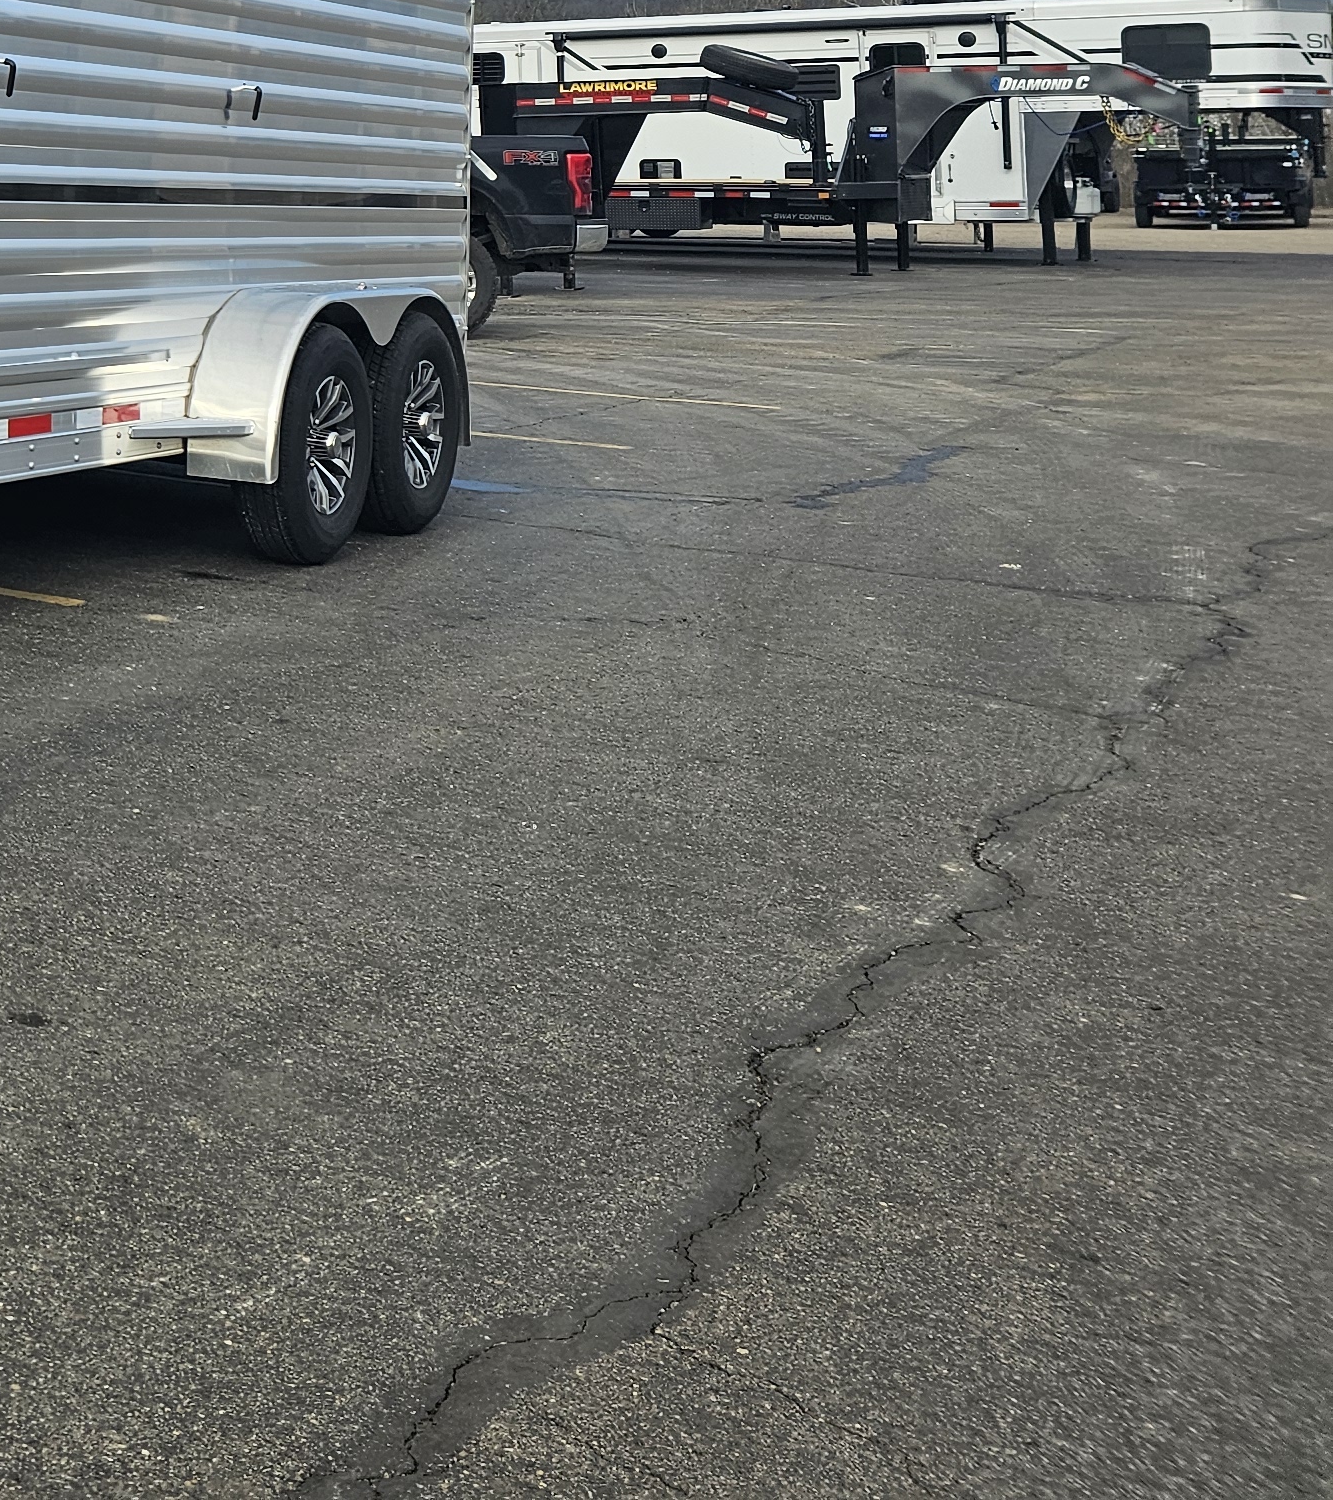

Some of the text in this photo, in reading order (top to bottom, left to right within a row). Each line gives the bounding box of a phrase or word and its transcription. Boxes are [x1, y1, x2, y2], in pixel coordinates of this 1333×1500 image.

[559, 80, 658, 93] LAWRIMORE
[1075, 76, 1091, 90] C
[503, 150, 559, 165] FX4
[773, 212, 798, 220] SWAY
[798, 213, 835, 221] CONTROL
